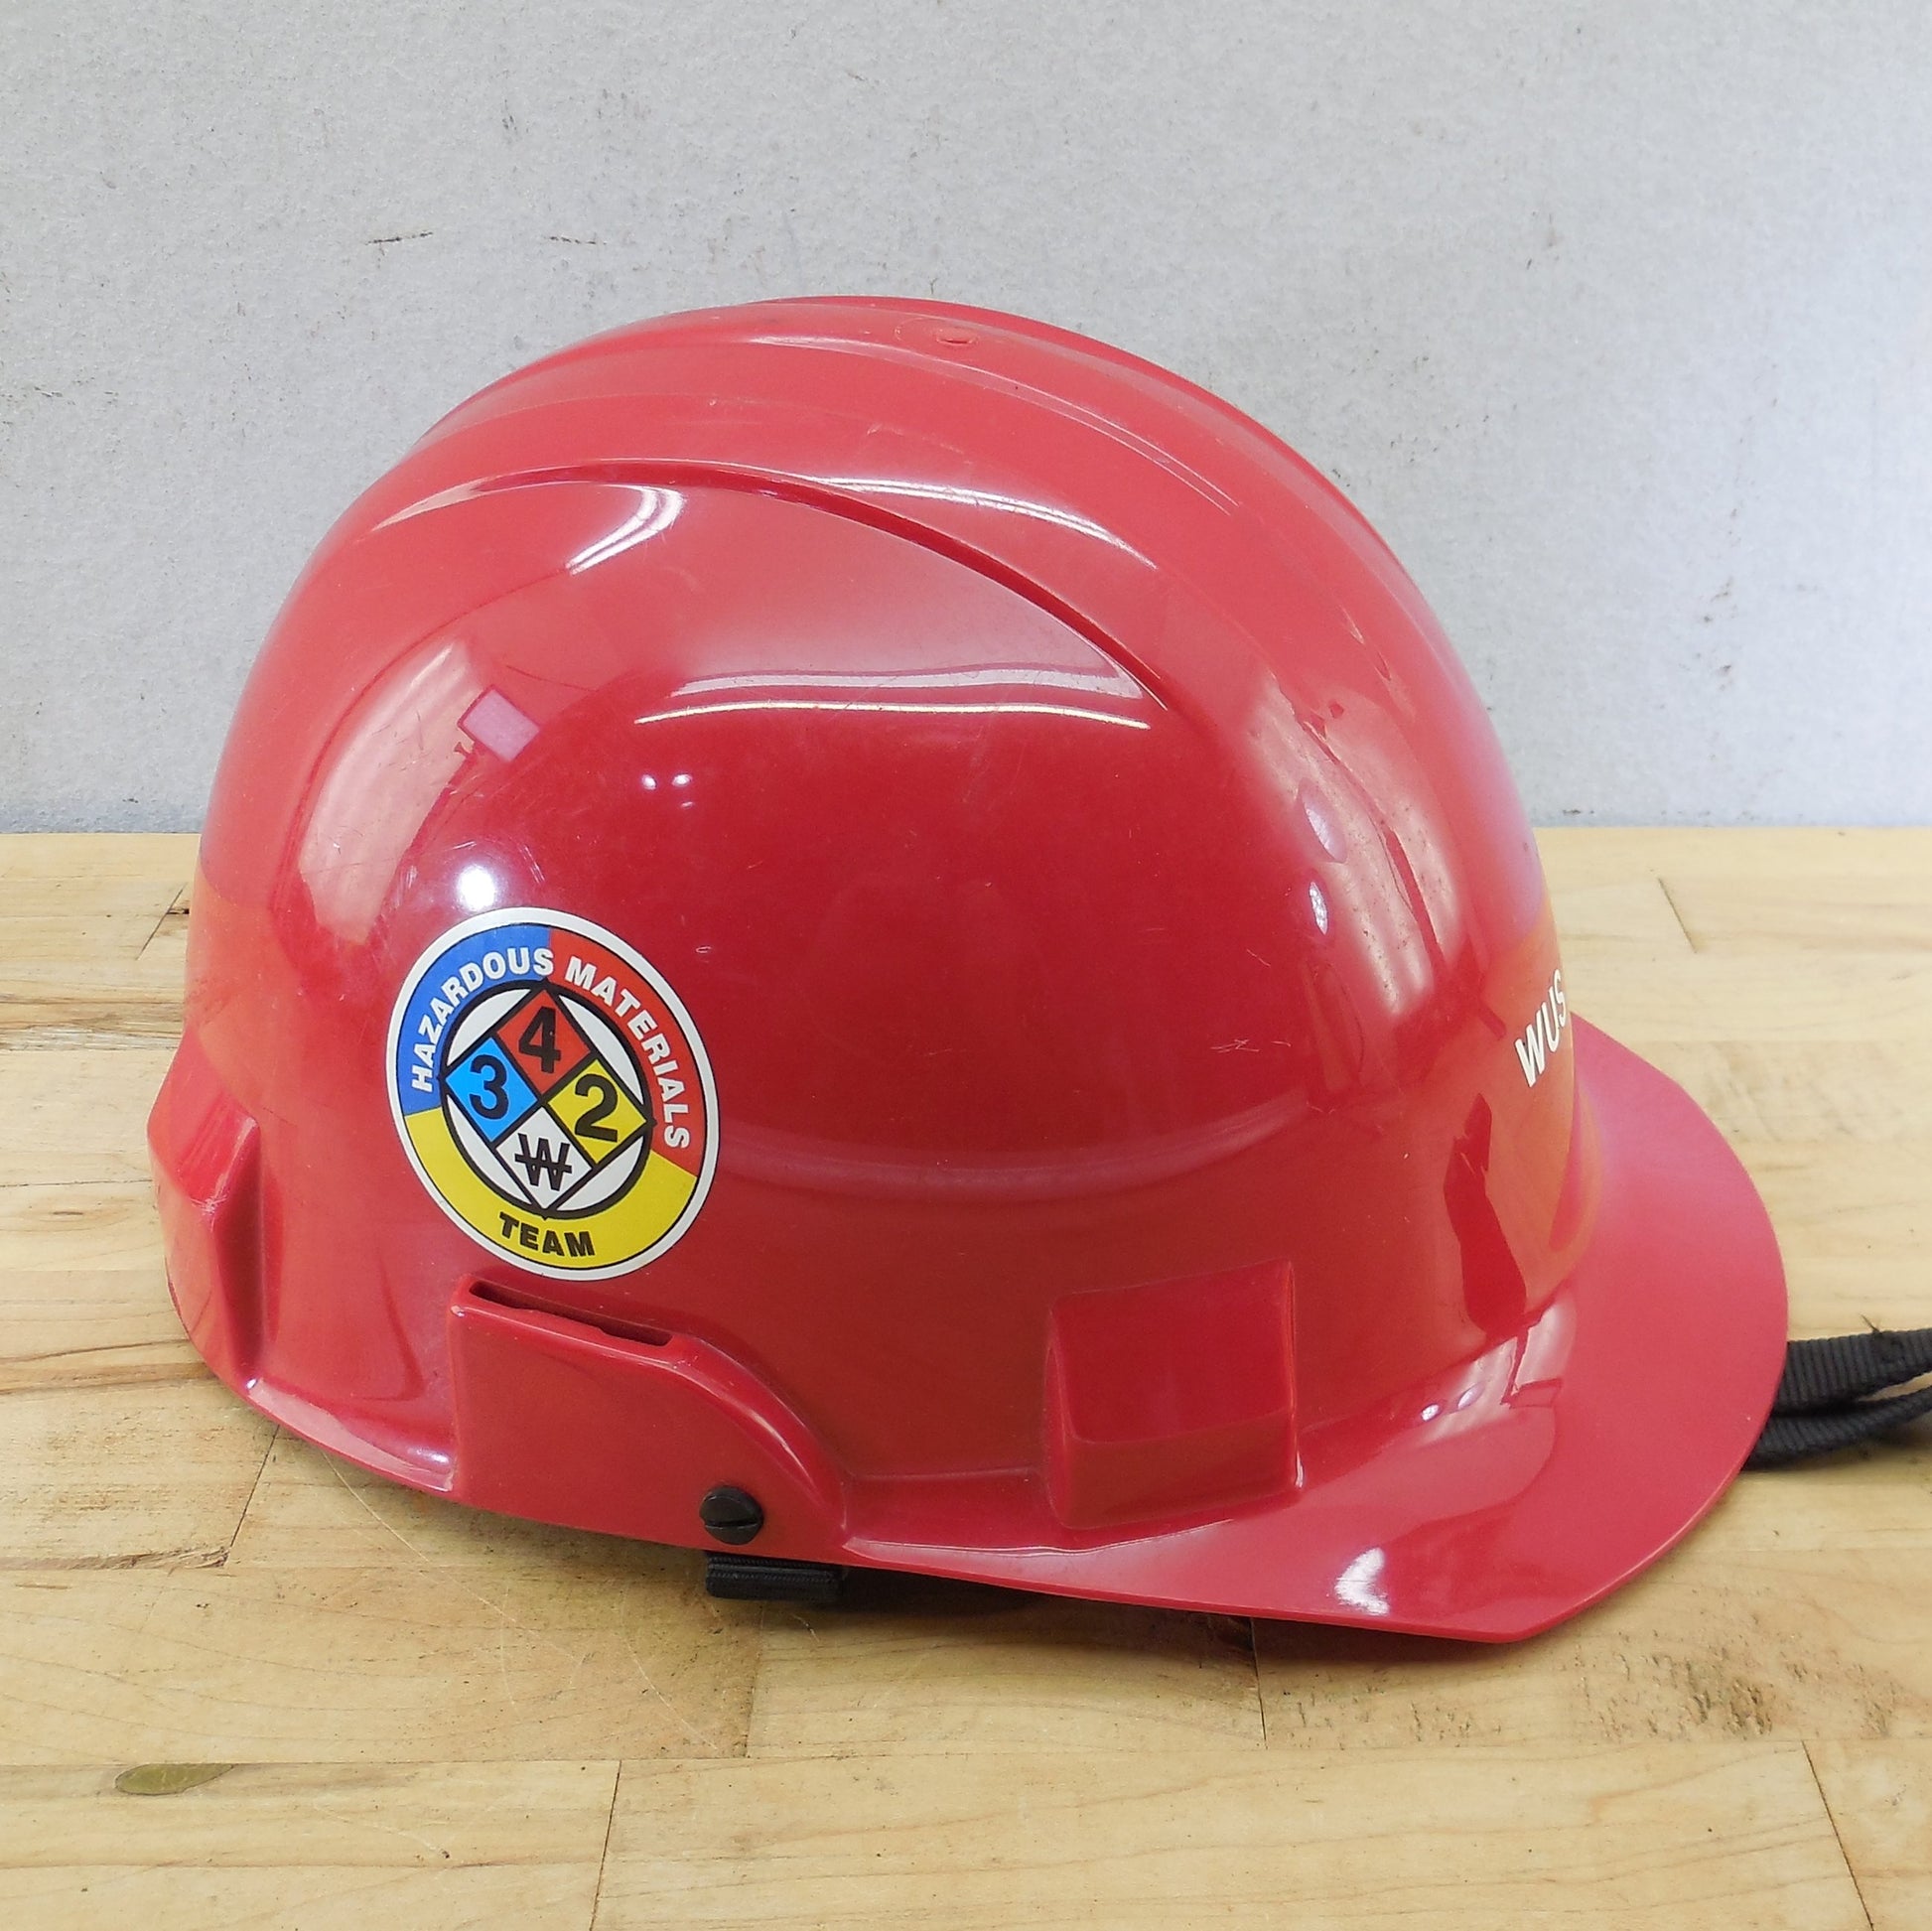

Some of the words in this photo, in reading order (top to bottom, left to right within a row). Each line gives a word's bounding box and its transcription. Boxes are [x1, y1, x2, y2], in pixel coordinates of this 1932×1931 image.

[411, 947, 554, 1092] HAZARDOUS
[565, 955, 690, 1150] MATERIALS
[518, 1006, 561, 1073] 4
[470, 1054, 509, 1120] 3
[574, 1073, 619, 1143] 2
[499, 1211, 596, 1257] TEAM
